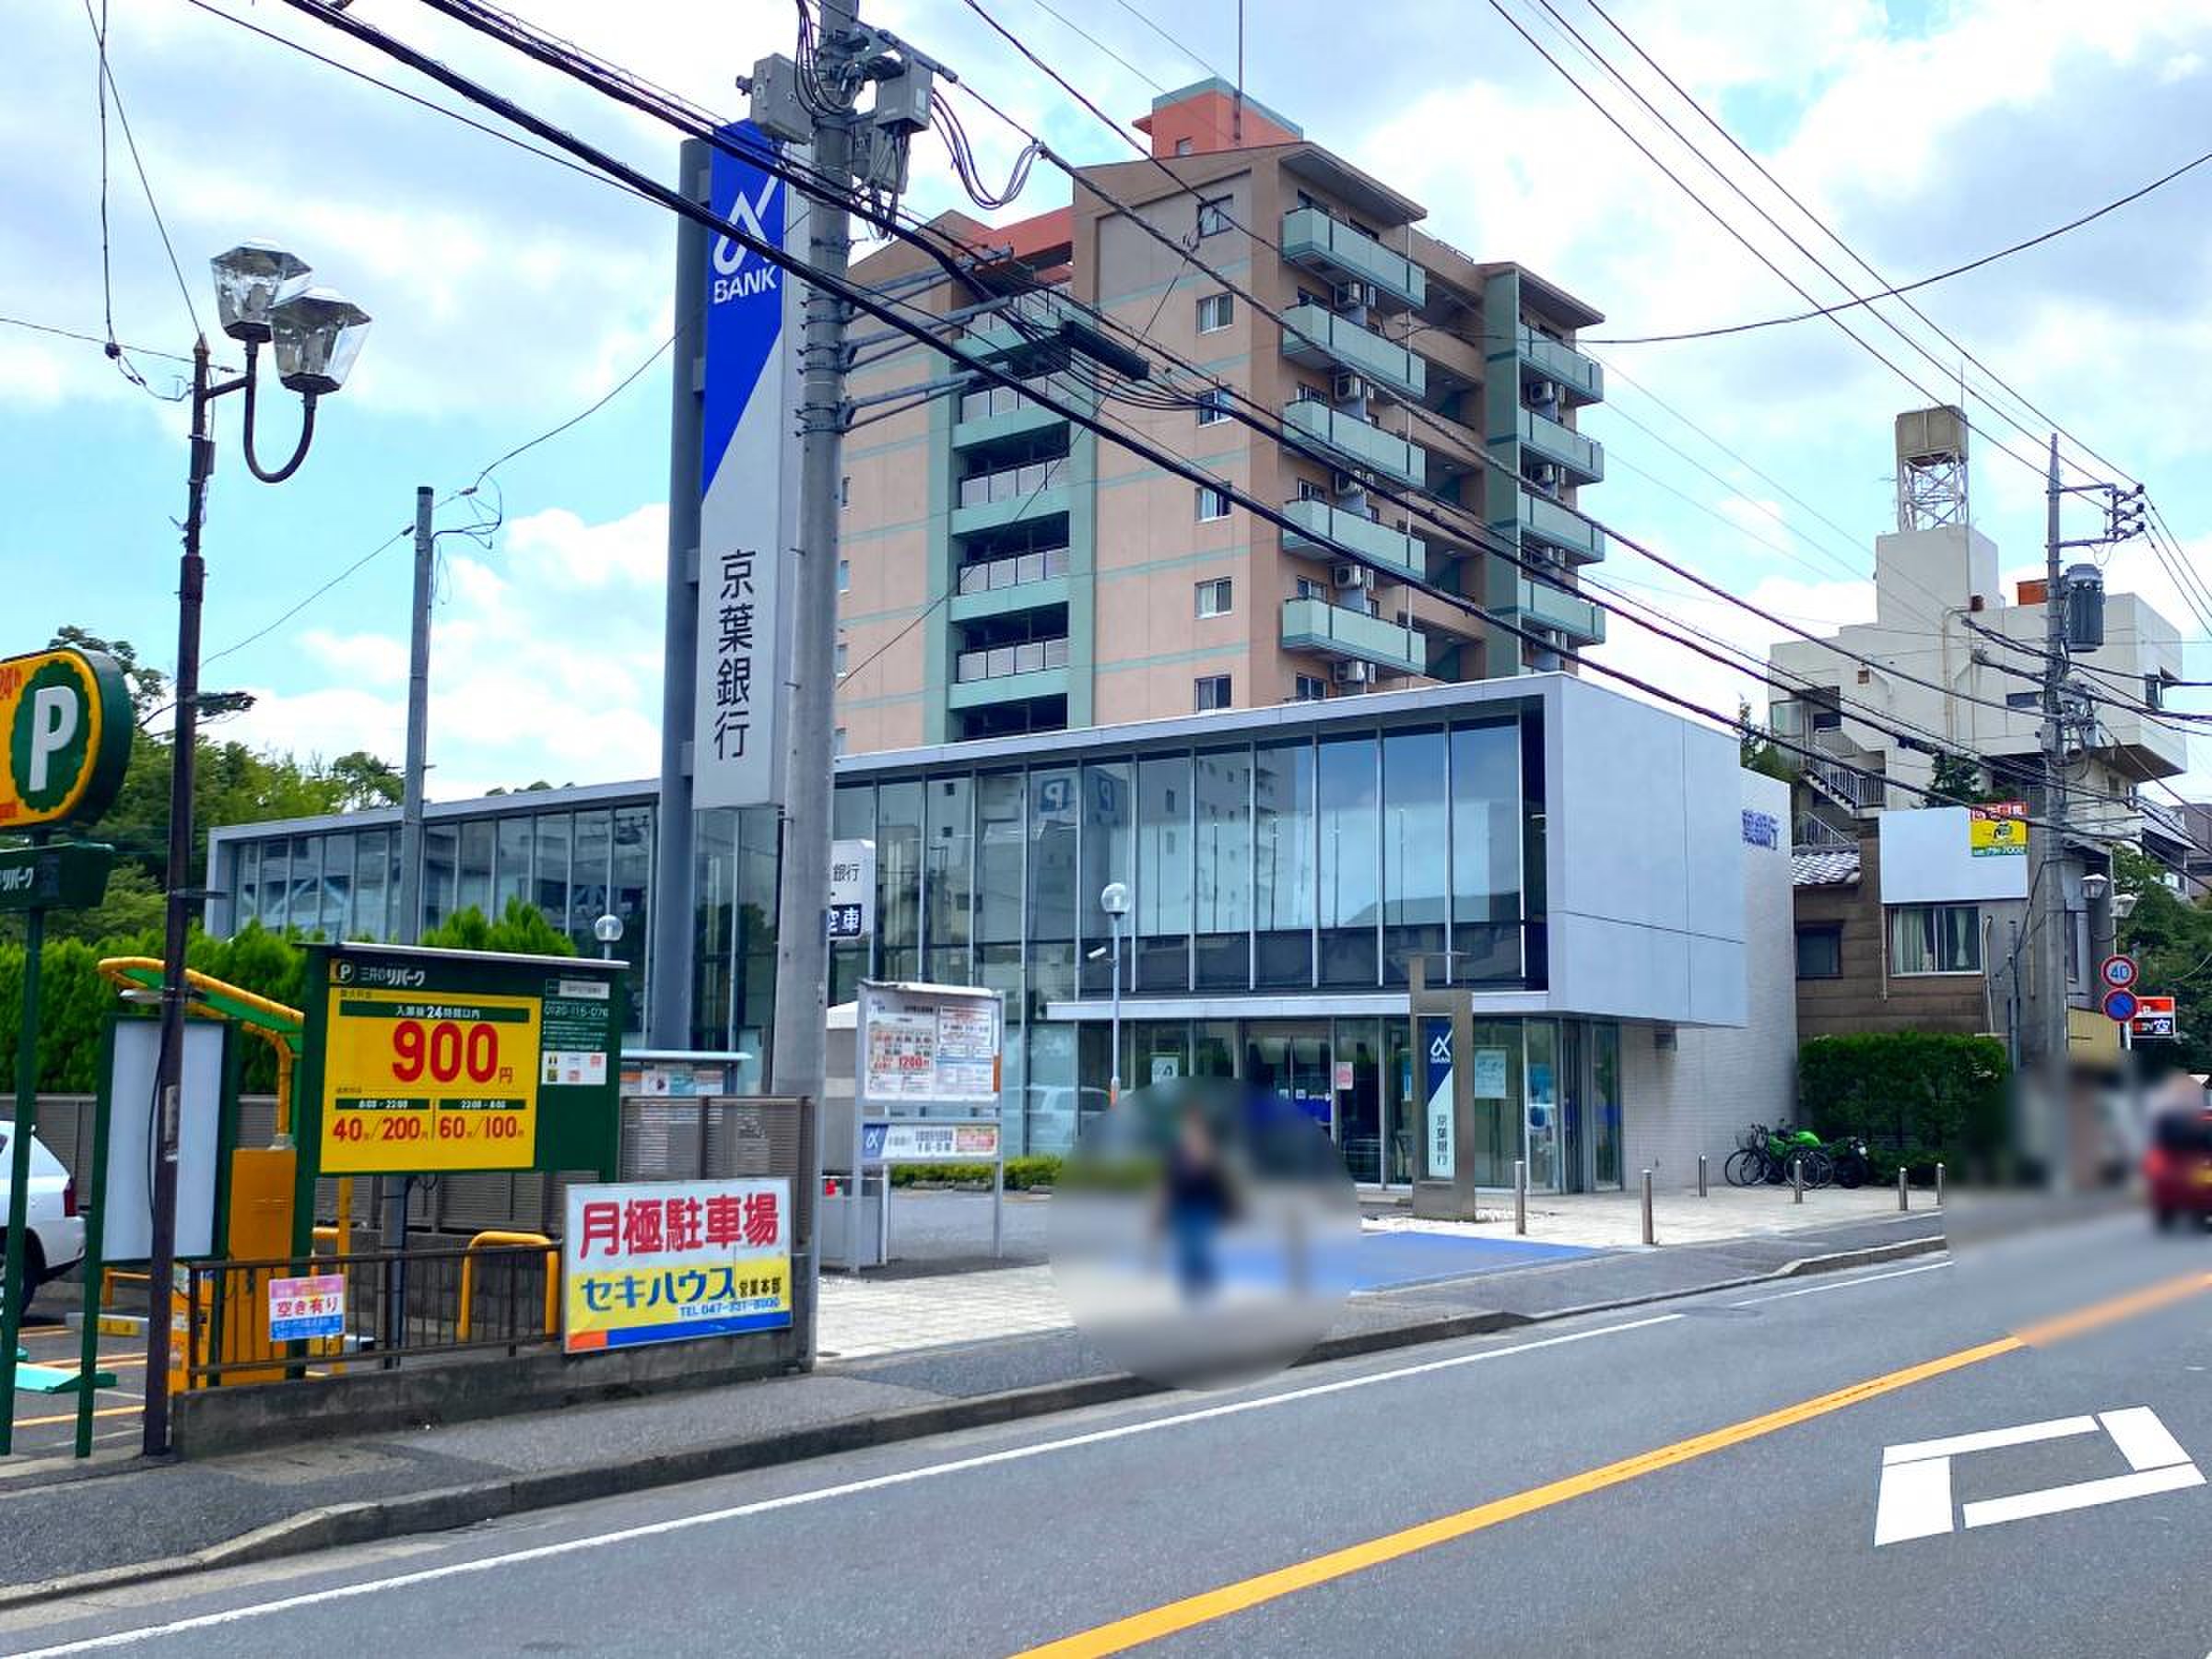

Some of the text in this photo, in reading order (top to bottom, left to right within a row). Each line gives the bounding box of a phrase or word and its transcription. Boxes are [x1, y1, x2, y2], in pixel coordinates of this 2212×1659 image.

[713, 265, 777, 304] BANK
[714, 548, 756, 760] 京葉銀行
[29, 685, 78, 792] P
[0, 867, 33, 890] リパーク
[360, 969, 425, 985] 三井のリパーク
[2110, 965, 2130, 979] 40
[580, 1193, 779, 1260] 月極駐車場
[276, 1297, 338, 1318] 空き有り
[581, 1267, 735, 1312] セキハウス
